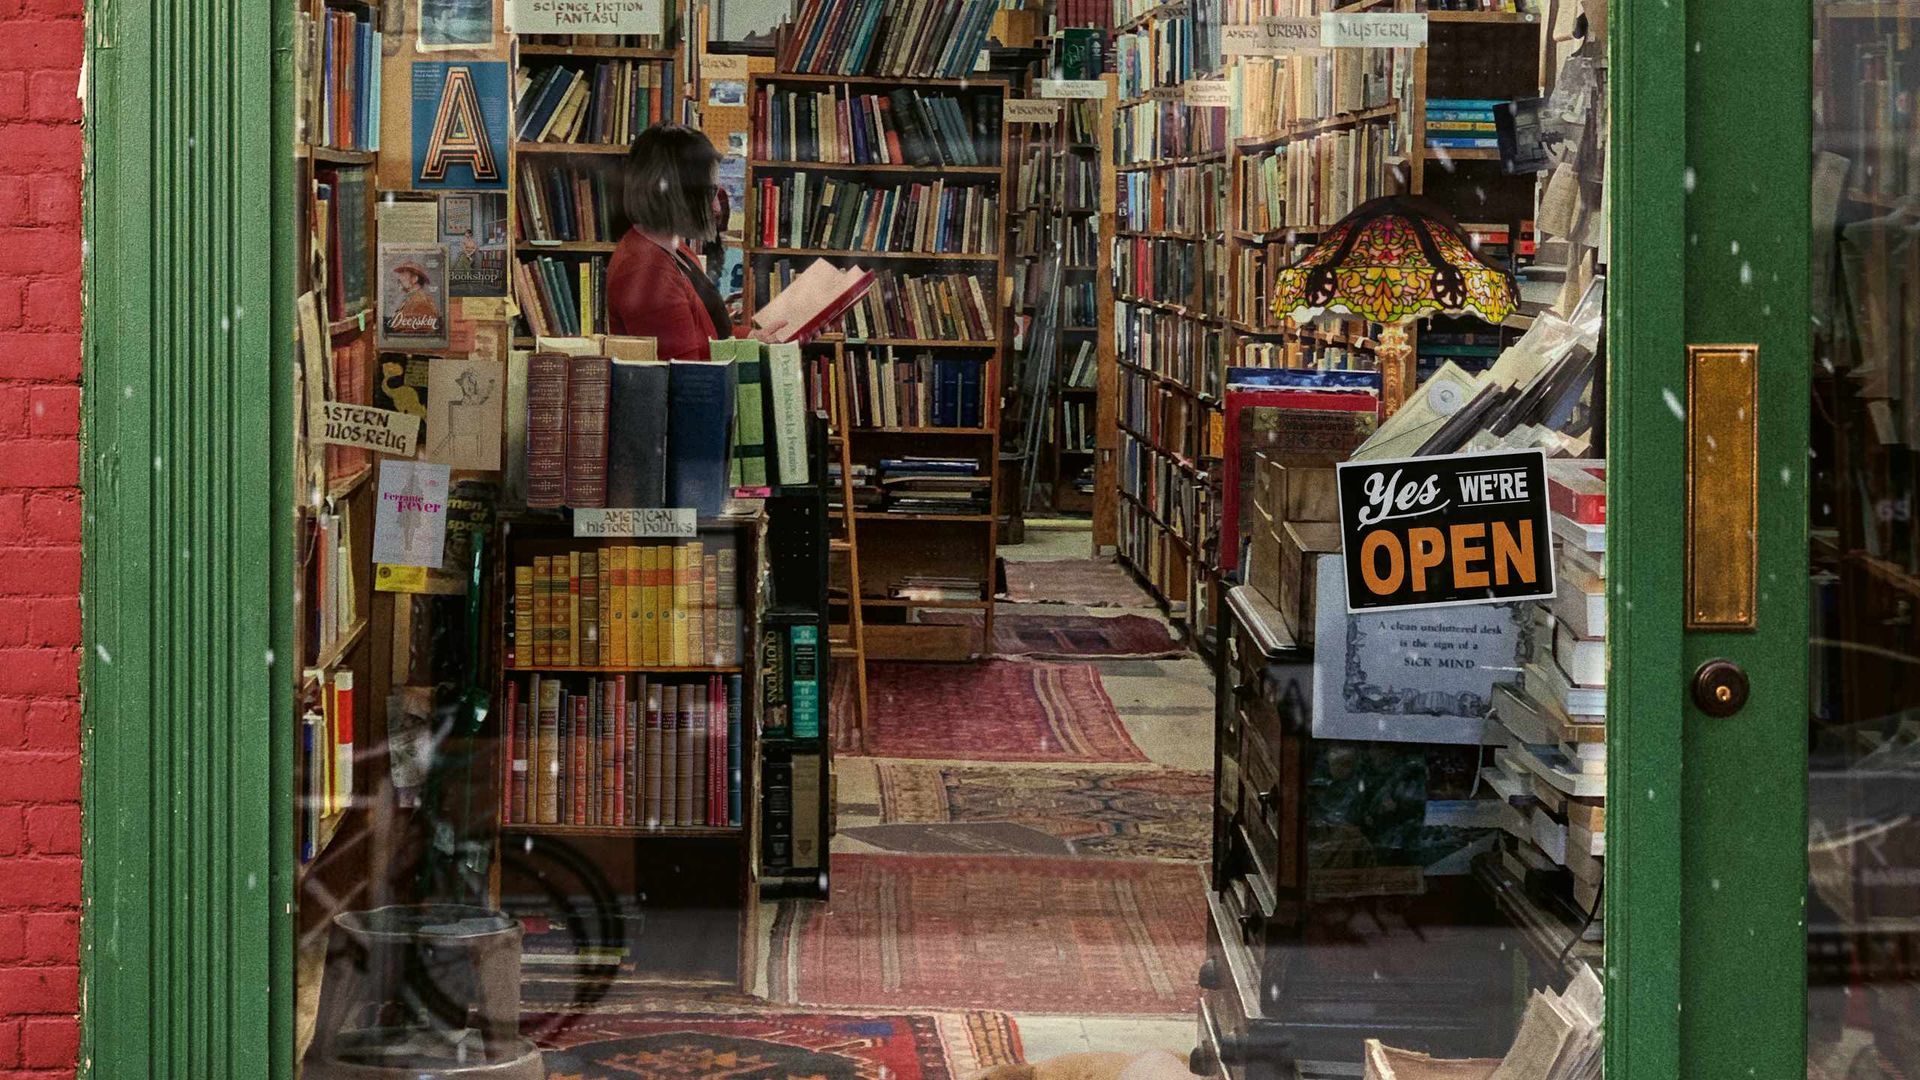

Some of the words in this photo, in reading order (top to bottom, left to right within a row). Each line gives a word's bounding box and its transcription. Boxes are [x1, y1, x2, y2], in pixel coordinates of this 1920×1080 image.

[533, 2, 590, 12] SCIENCE
[596, 2, 644, 13] FICTION
[555, 12, 619, 27] FANTASY
[1266, 22, 1307, 39] URBAN
[1338, 22, 1410, 42] MYSTERY
[383, 491, 424, 503] Ferrante
[1357, 469, 1450, 531] Yes
[1459, 471, 1529, 503] WE'RE
[397, 500, 441, 513] Fever
[604, 511, 673, 523] AMERICAN
[586, 521, 636, 535] HISTORY
[1360, 519, 1537, 596] OPEN
[1379, 621, 1386, 630] A
[1390, 622, 1418, 631] clean
[1420, 624, 1477, 634] uncluttered
[1480, 625, 1503, 635] desk
[1400, 640, 1408, 648] is
[1412, 638, 1428, 649] the
[1433, 641, 1454, 651] sign
[1458, 641, 1469, 650] of
[764, 630, 778, 703] QUOTATIONS
[1404, 657, 1432, 668] SICK
[1438, 658, 1475, 669] MIND
